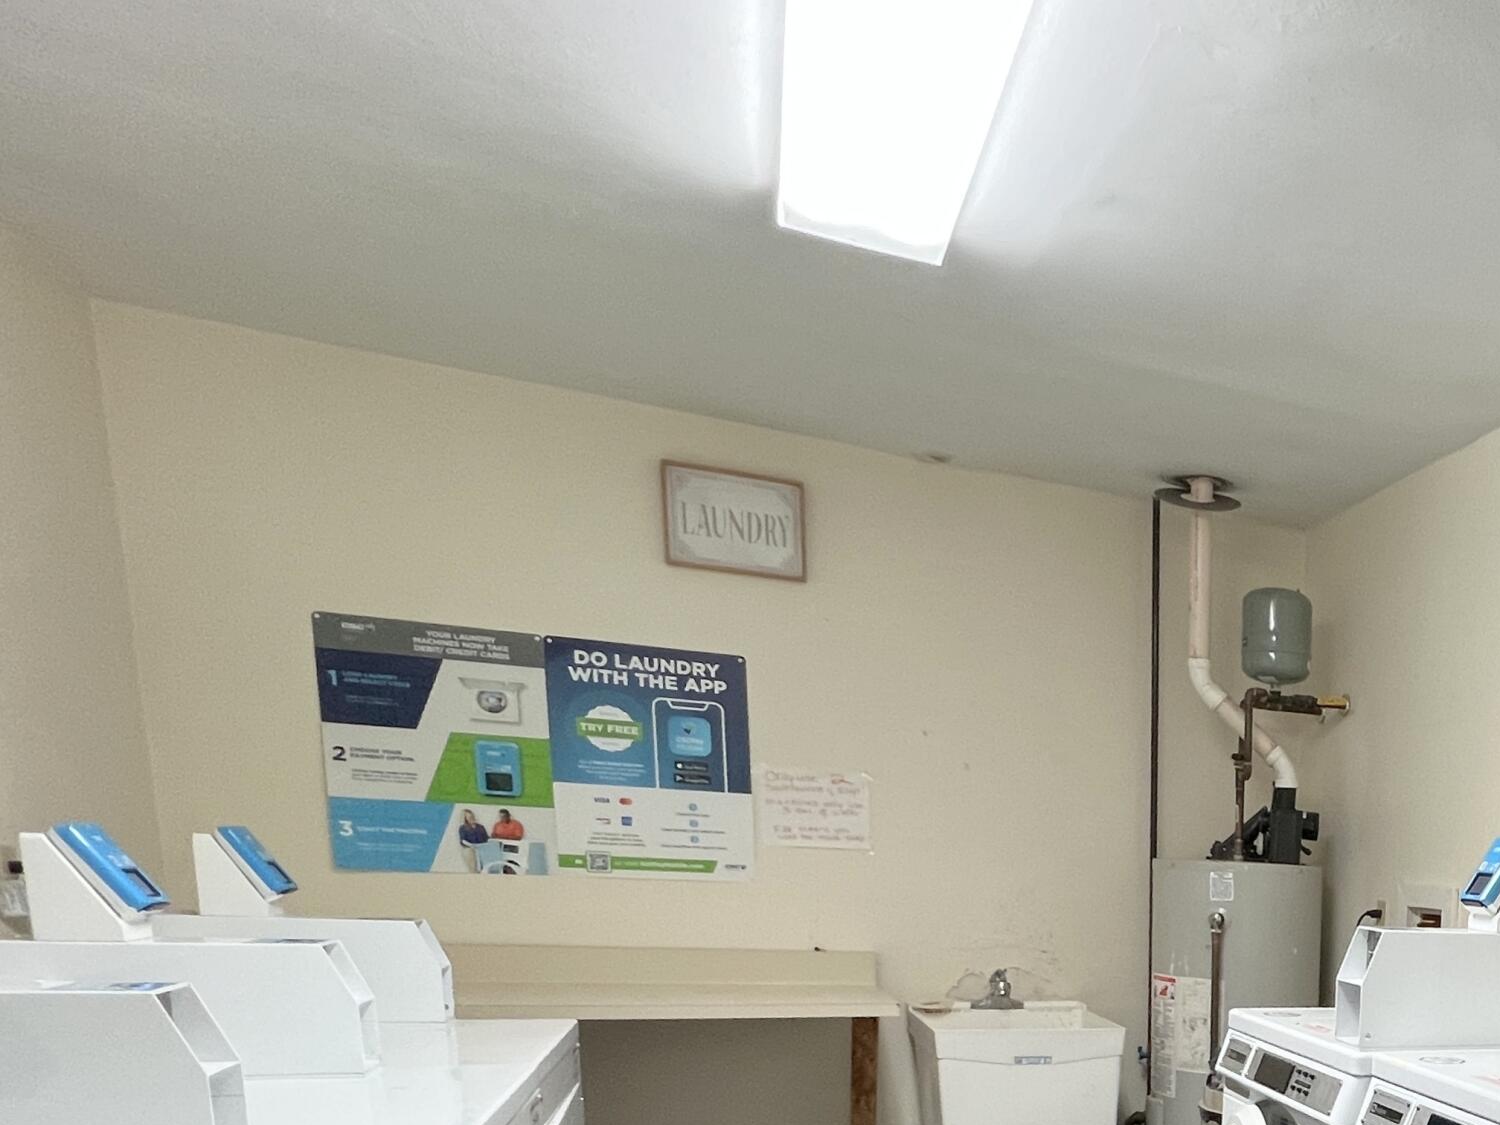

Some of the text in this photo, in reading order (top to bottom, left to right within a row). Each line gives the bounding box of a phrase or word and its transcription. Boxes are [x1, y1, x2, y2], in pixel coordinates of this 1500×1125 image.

[681, 501, 789, 548] LAUNDRY
[573, 649, 721, 679] DO LAUNDRY
[328, 669, 338, 687] 1
[568, 666, 728, 695] WITH THE APP
[580, 722, 639, 735] TRY FREE
[332, 745, 347, 762] 2
[338, 820, 354, 837] 3
